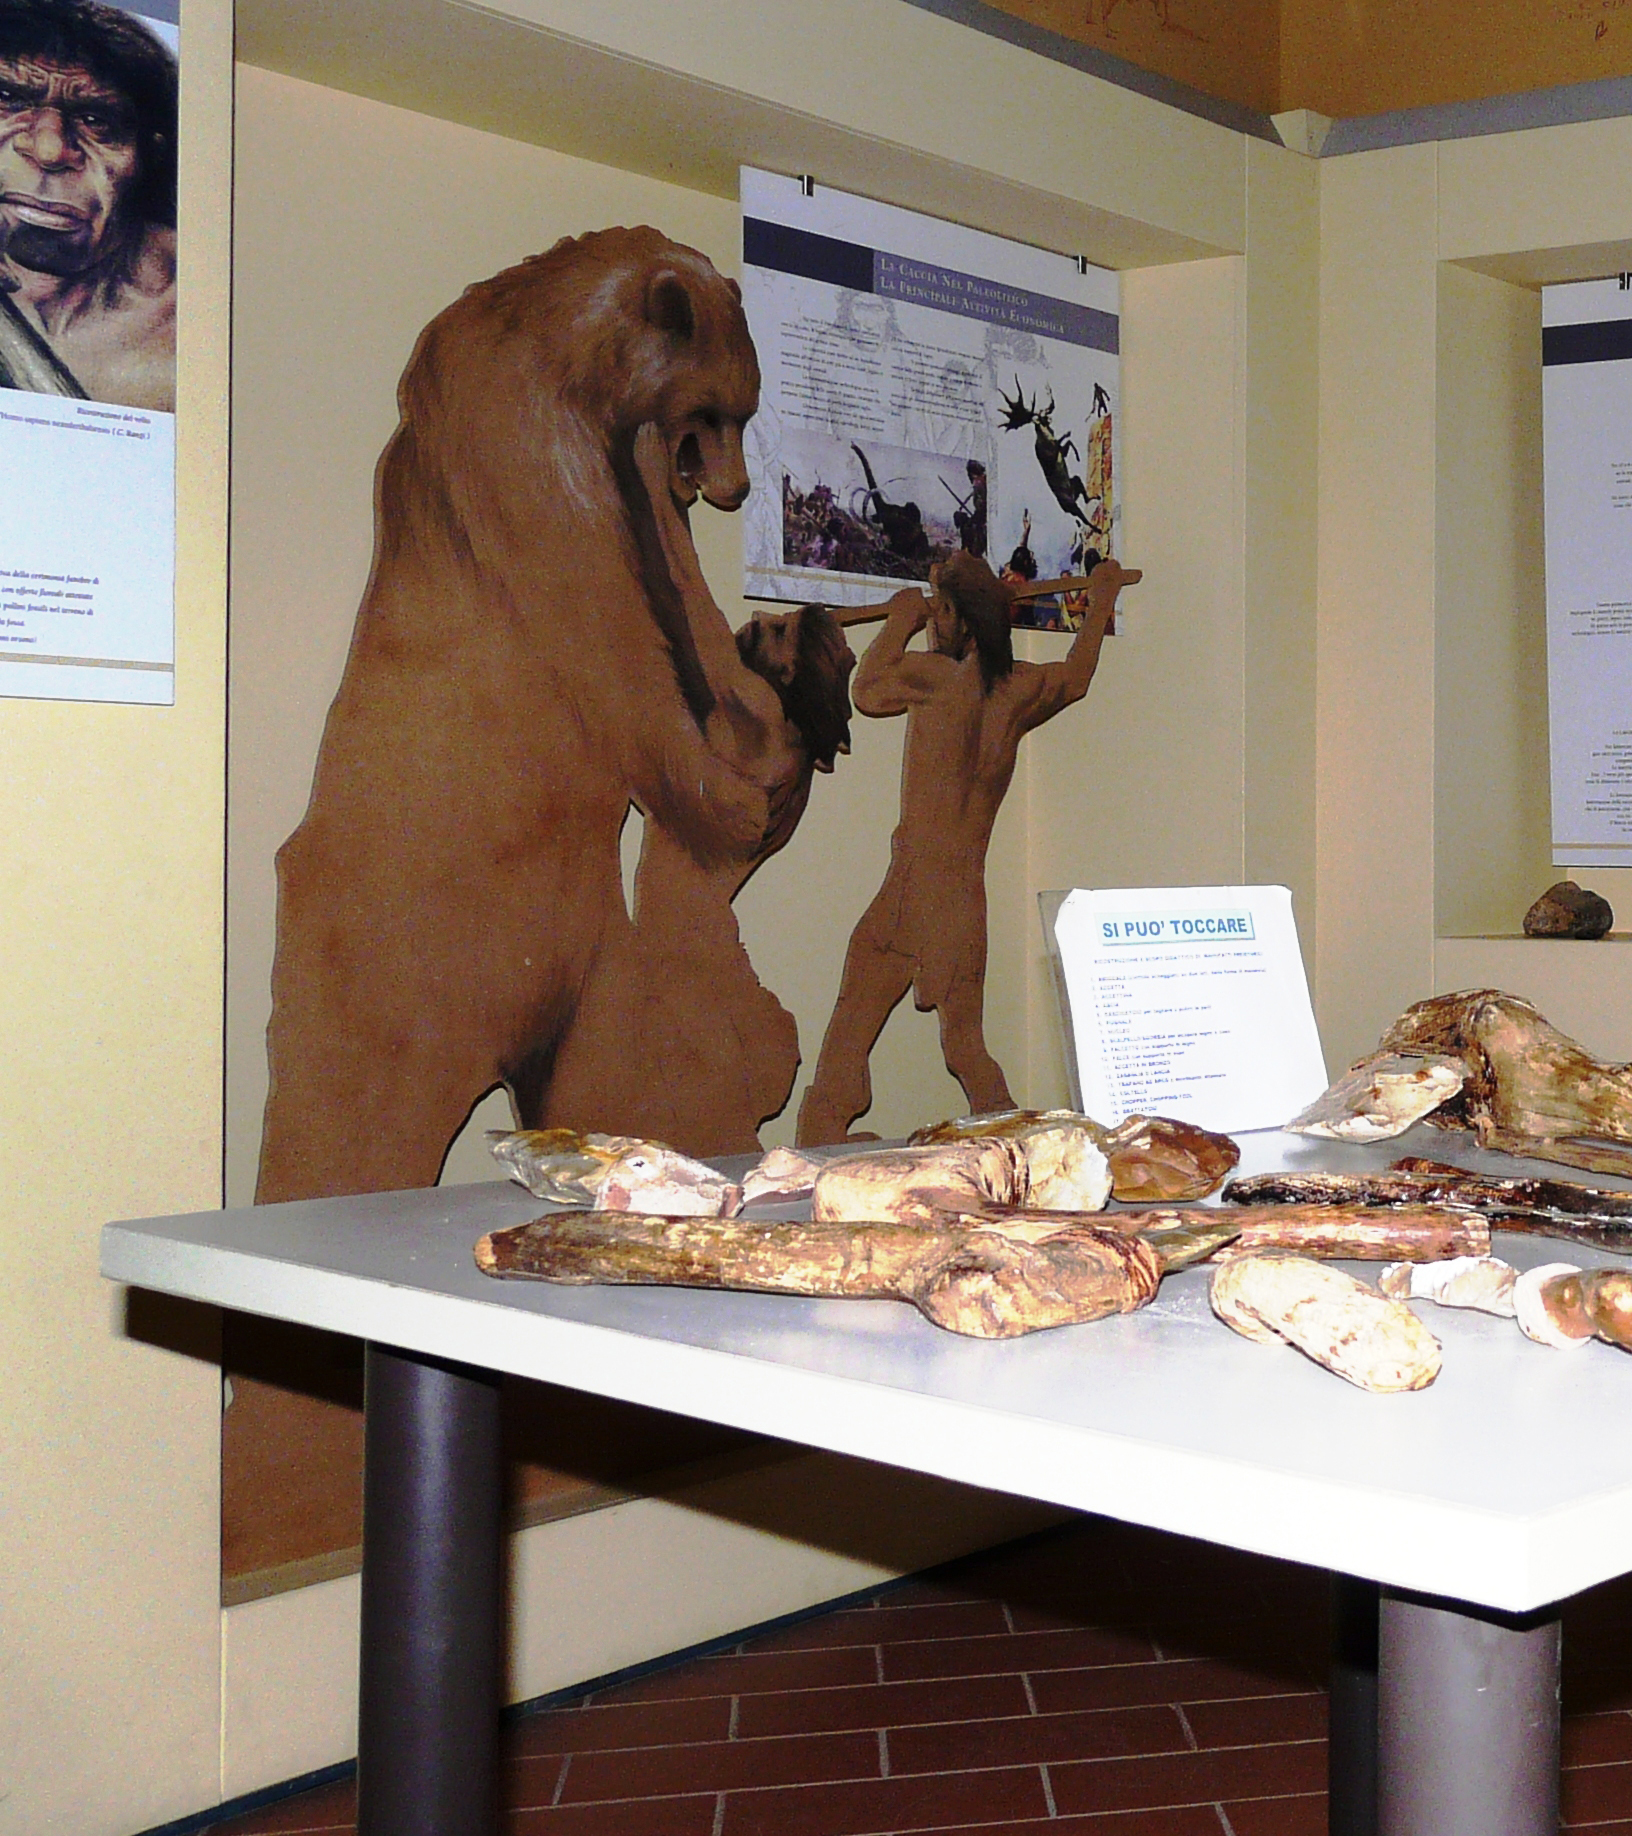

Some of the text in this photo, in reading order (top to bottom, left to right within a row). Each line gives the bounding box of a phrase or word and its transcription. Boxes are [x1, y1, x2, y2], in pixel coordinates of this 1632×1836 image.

[1103, 918, 1248, 938] SI PUO' TOCCARE
